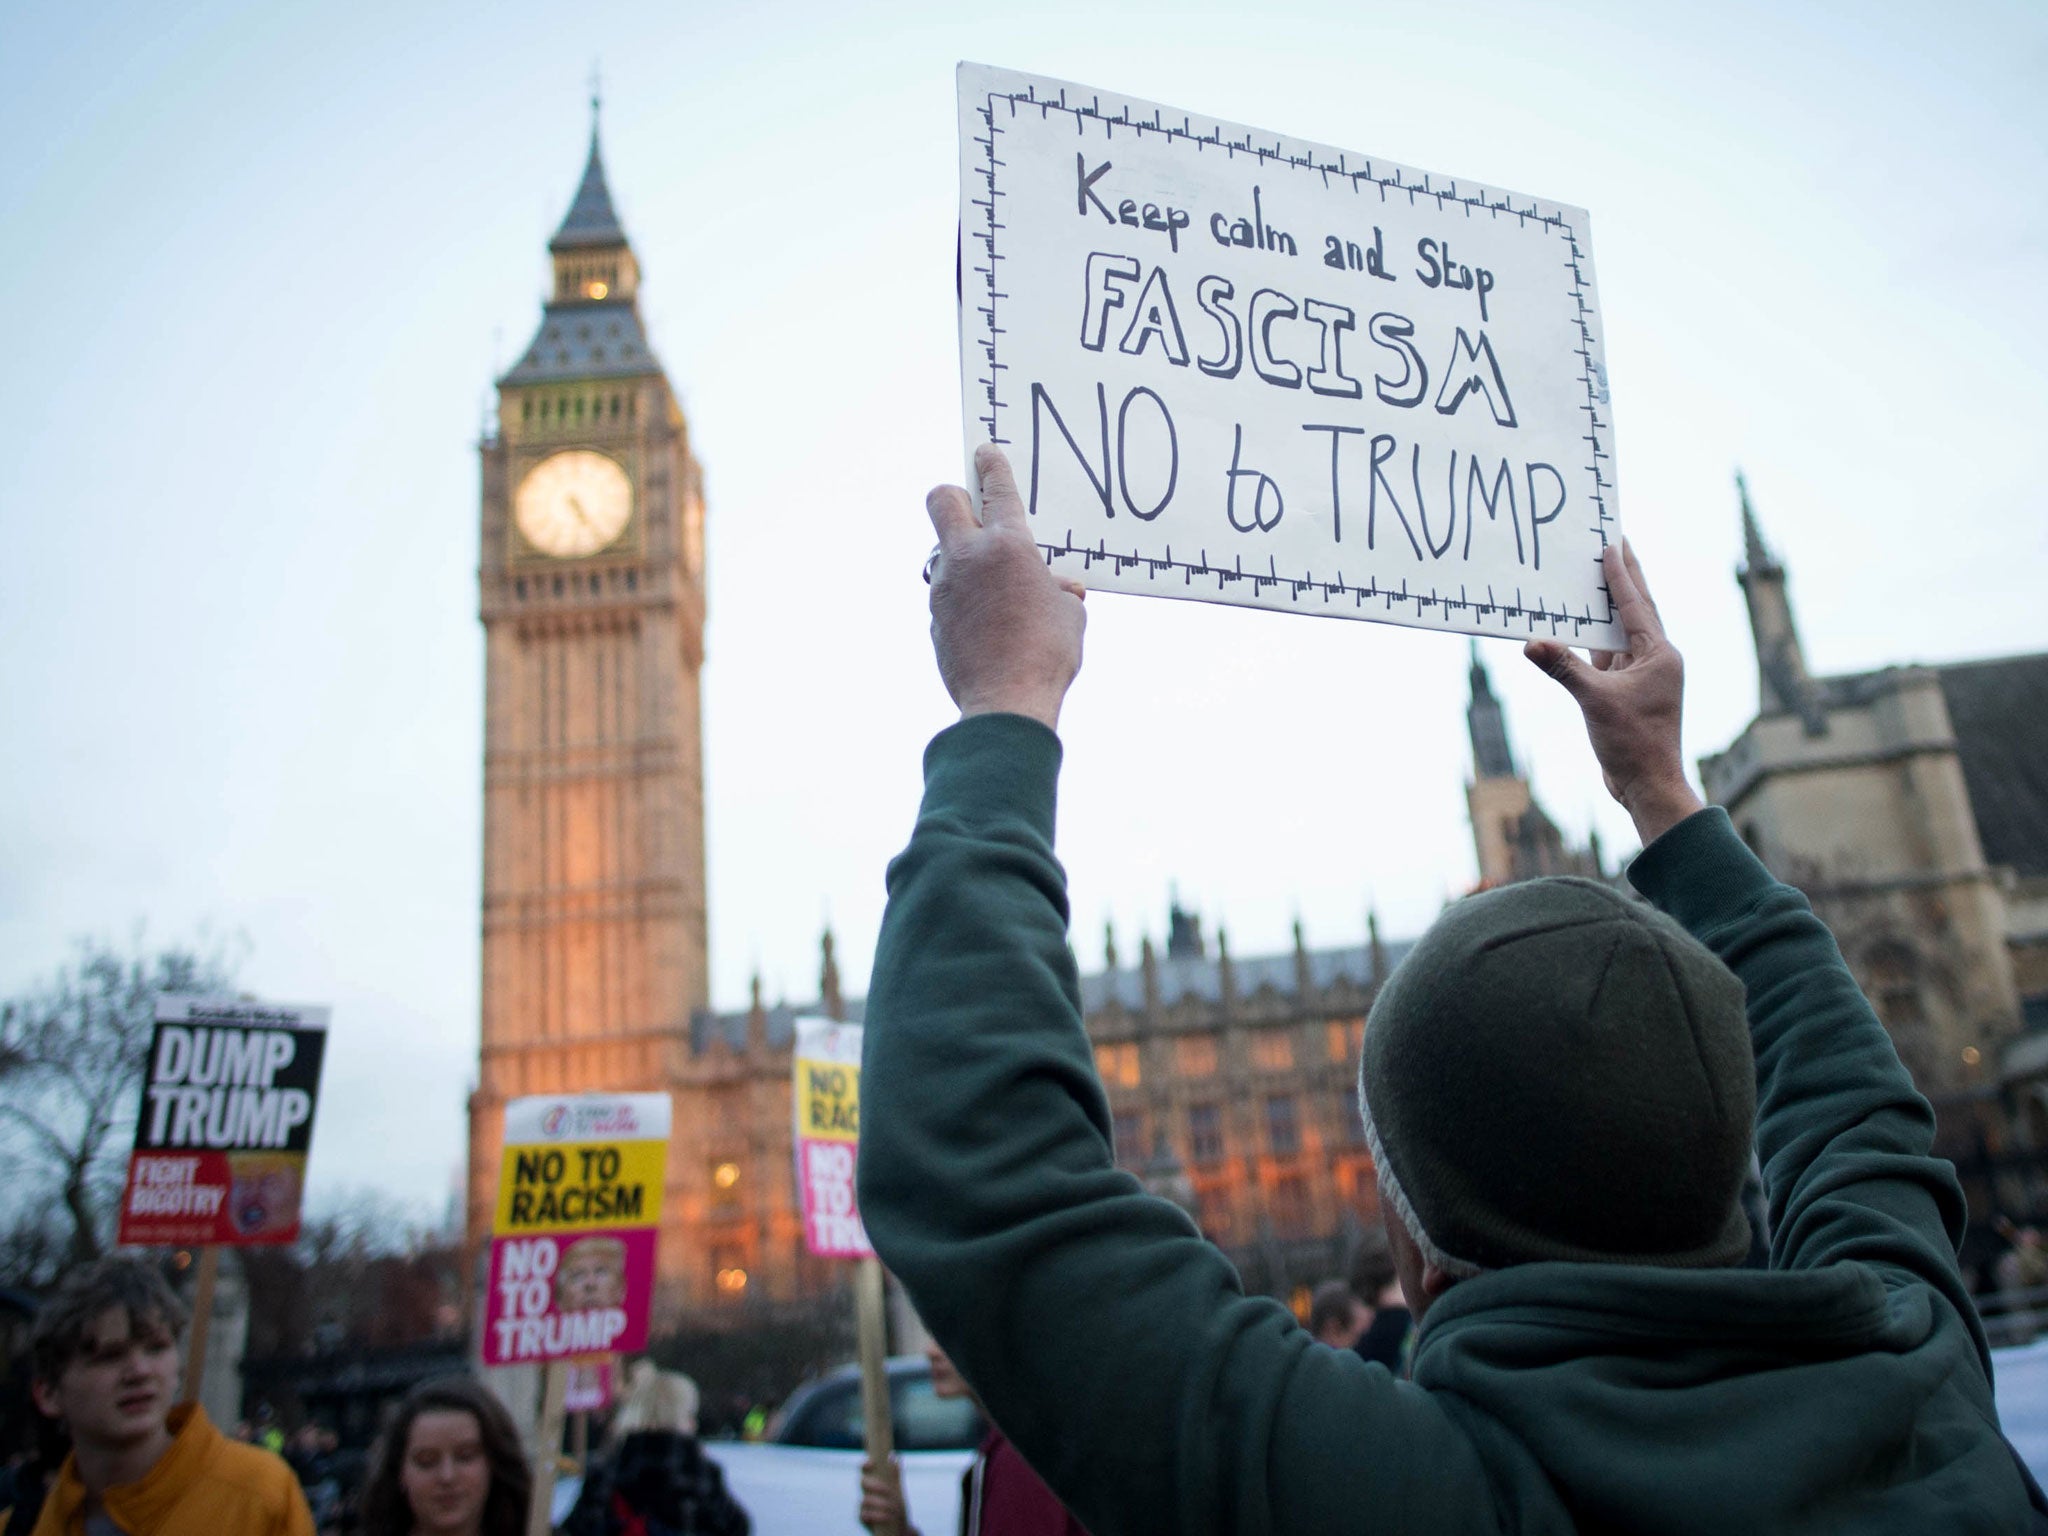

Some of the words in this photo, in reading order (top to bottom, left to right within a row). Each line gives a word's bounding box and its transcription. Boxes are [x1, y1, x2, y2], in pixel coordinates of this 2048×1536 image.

[1078, 153, 1190, 252] Keep
[1211, 186, 1298, 256] calm
[1324, 227, 1397, 282] and
[1416, 237, 1494, 321] Stop
[1080, 251, 1518, 427] FASCISM
[1029, 381, 1179, 521] NO
[1226, 423, 1284, 533] to
[1303, 424, 1566, 570] TRUMP
[154, 1025, 296, 1088] DUMP
[810, 1066, 847, 1099] NO
[147, 1084, 310, 1148] TRUMP
[810, 1100, 860, 1133] RAC
[515, 1150, 565, 1185] NO
[578, 1147, 621, 1182] TO
[809, 1144, 853, 1180] NO
[510, 1183, 645, 1225] RACISM
[813, 1179, 852, 1216] TO
[812, 1213, 875, 1252] TRU
[502, 1237, 559, 1280] NO
[499, 1279, 550, 1316] TO
[493, 1308, 627, 1361] TRUMP
